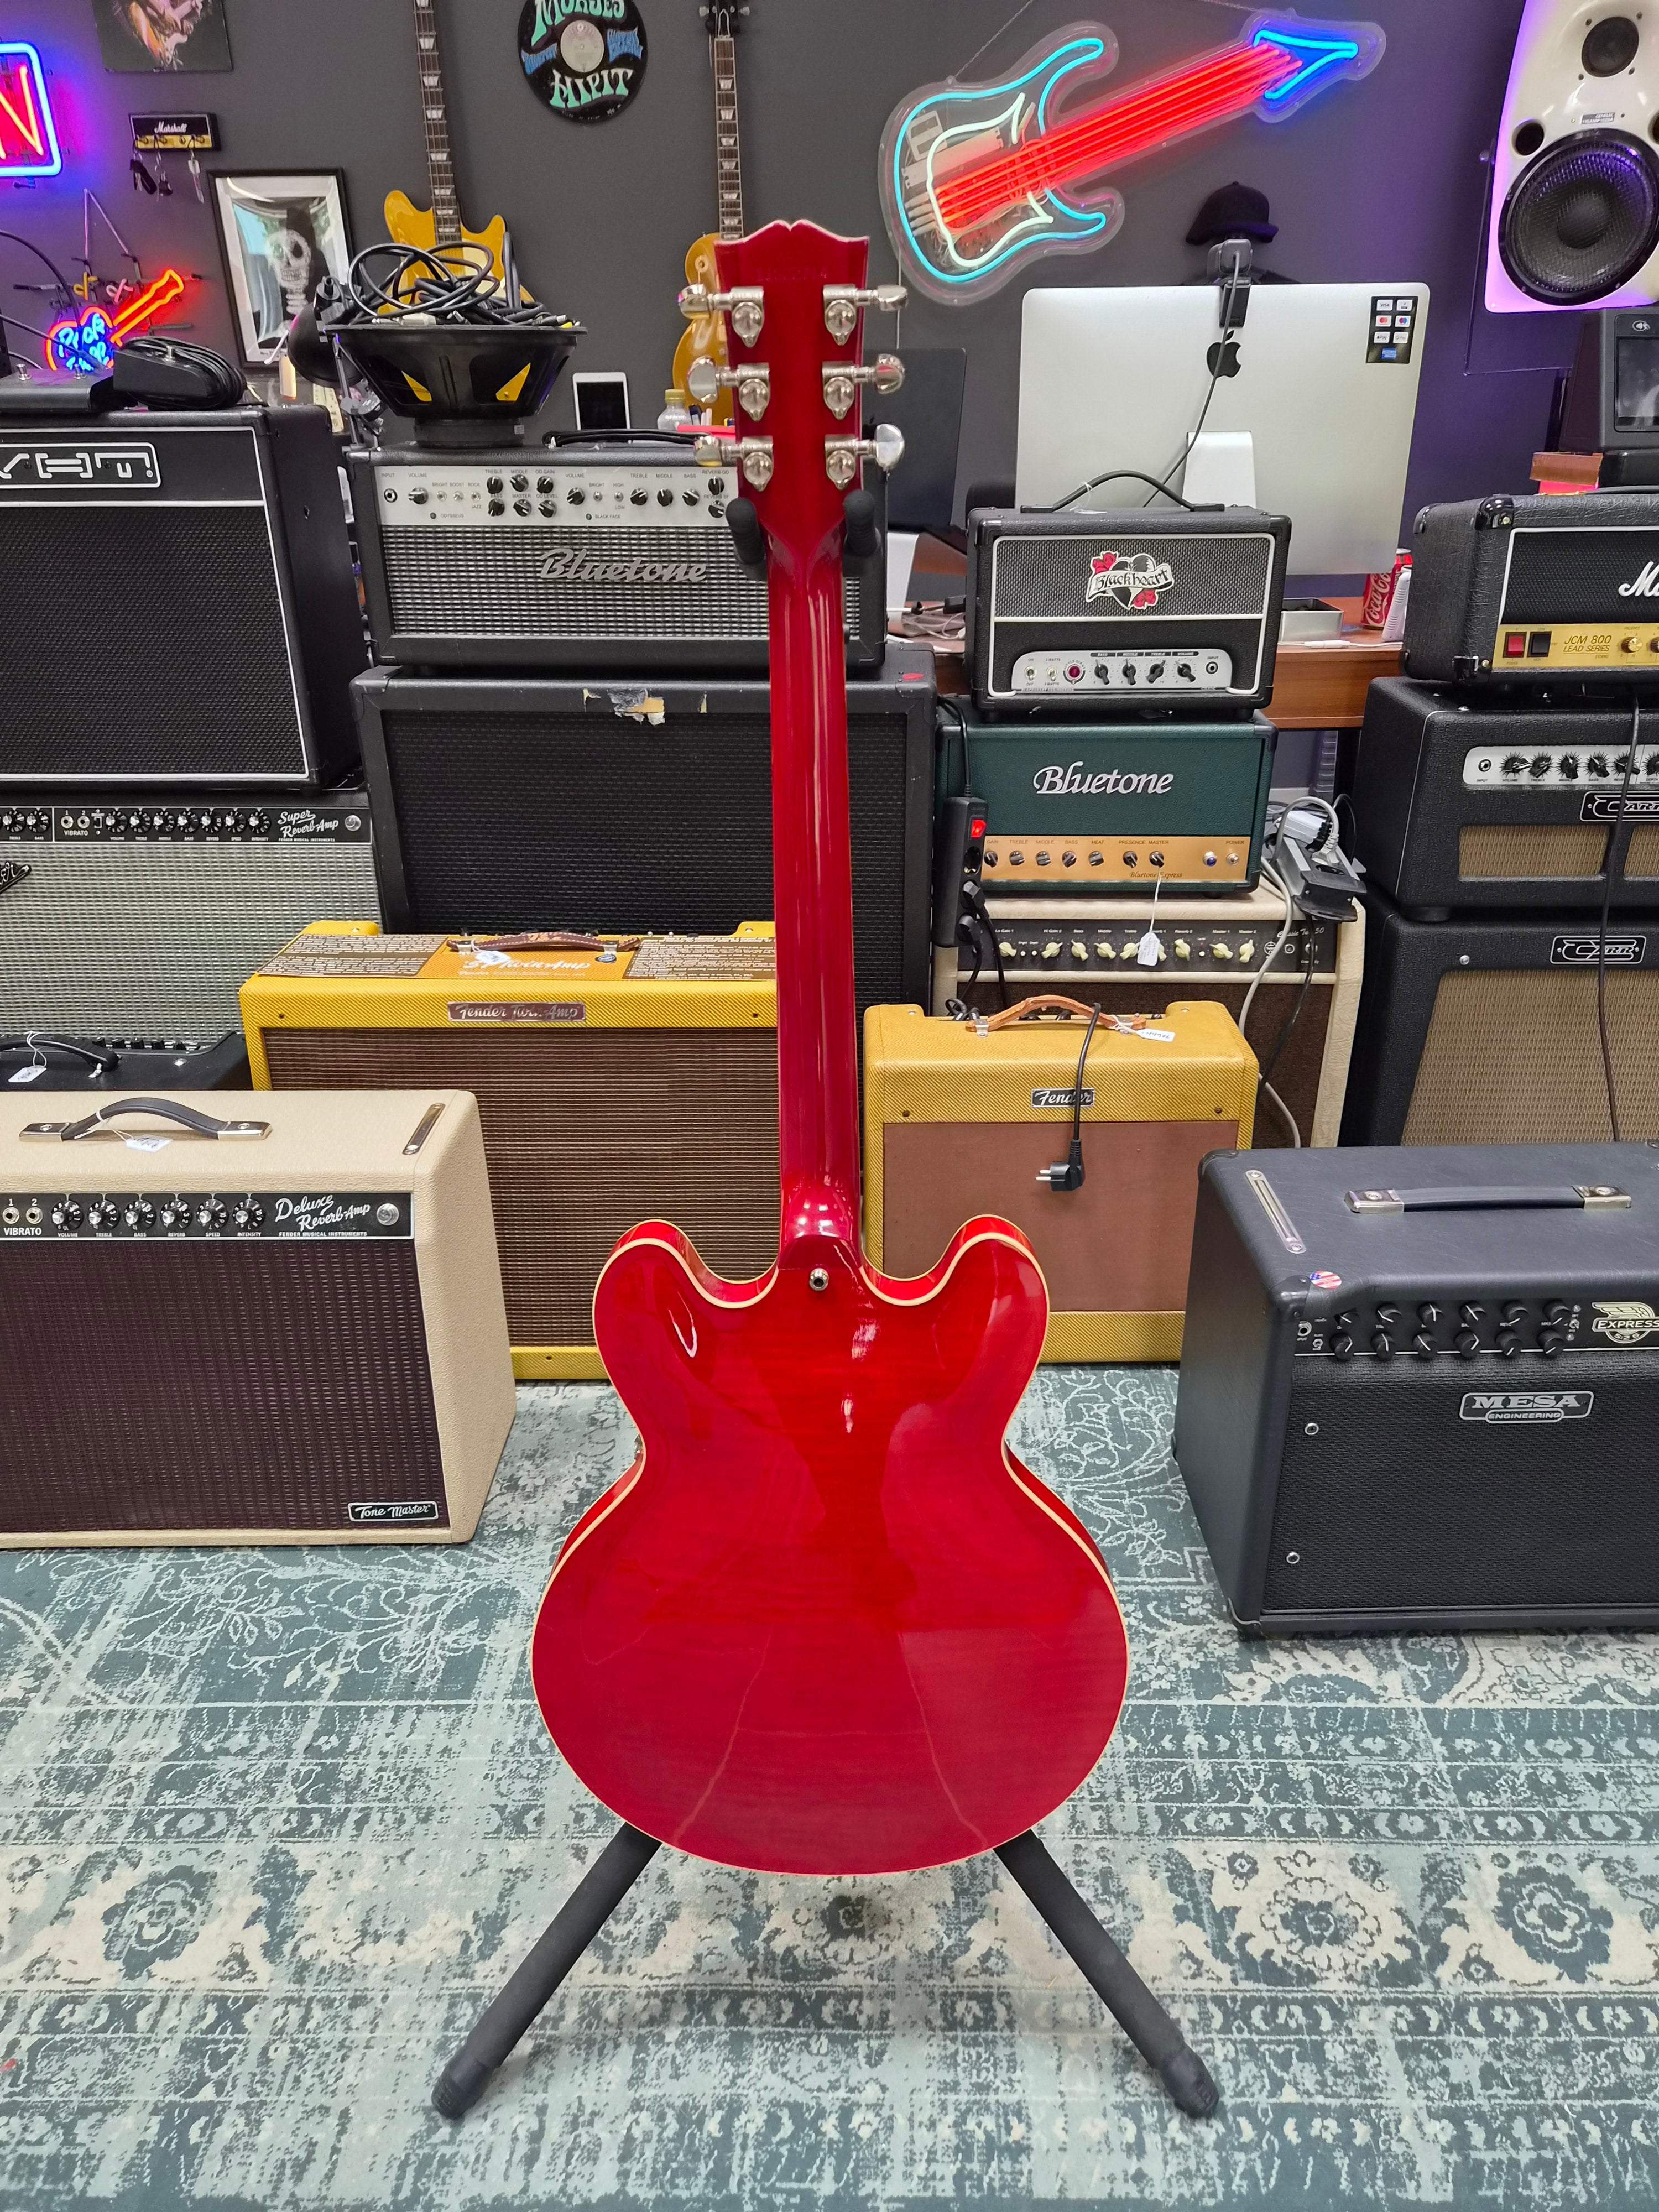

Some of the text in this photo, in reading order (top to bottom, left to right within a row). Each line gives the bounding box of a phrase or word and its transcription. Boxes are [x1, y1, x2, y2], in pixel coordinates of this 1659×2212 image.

[550, 68, 634, 108] HIPIT
[154, 121, 187, 133] Marshall
[540, 548, 707, 581] Bluetone
[1097, 569, 1169, 591] Blackheart
[1564, 635, 1611, 644] JCM 800
[1033, 761, 1173, 794] Bluetone
[277, 809, 316, 825] Super
[280, 818, 339, 838] Reverb-Amp
[456, 1004, 507, 1019] Fender
[275, 1194, 334, 1222] Deluxe
[296, 1204, 371, 1232] Reverb-Amp
[3, 1227, 42, 1235] VIBRATO
[1597, 1319, 1659, 1329] EXPRESS
[1472, 1395, 1580, 1408] MESA
[354, 1504, 429, 1519] Tone Master
